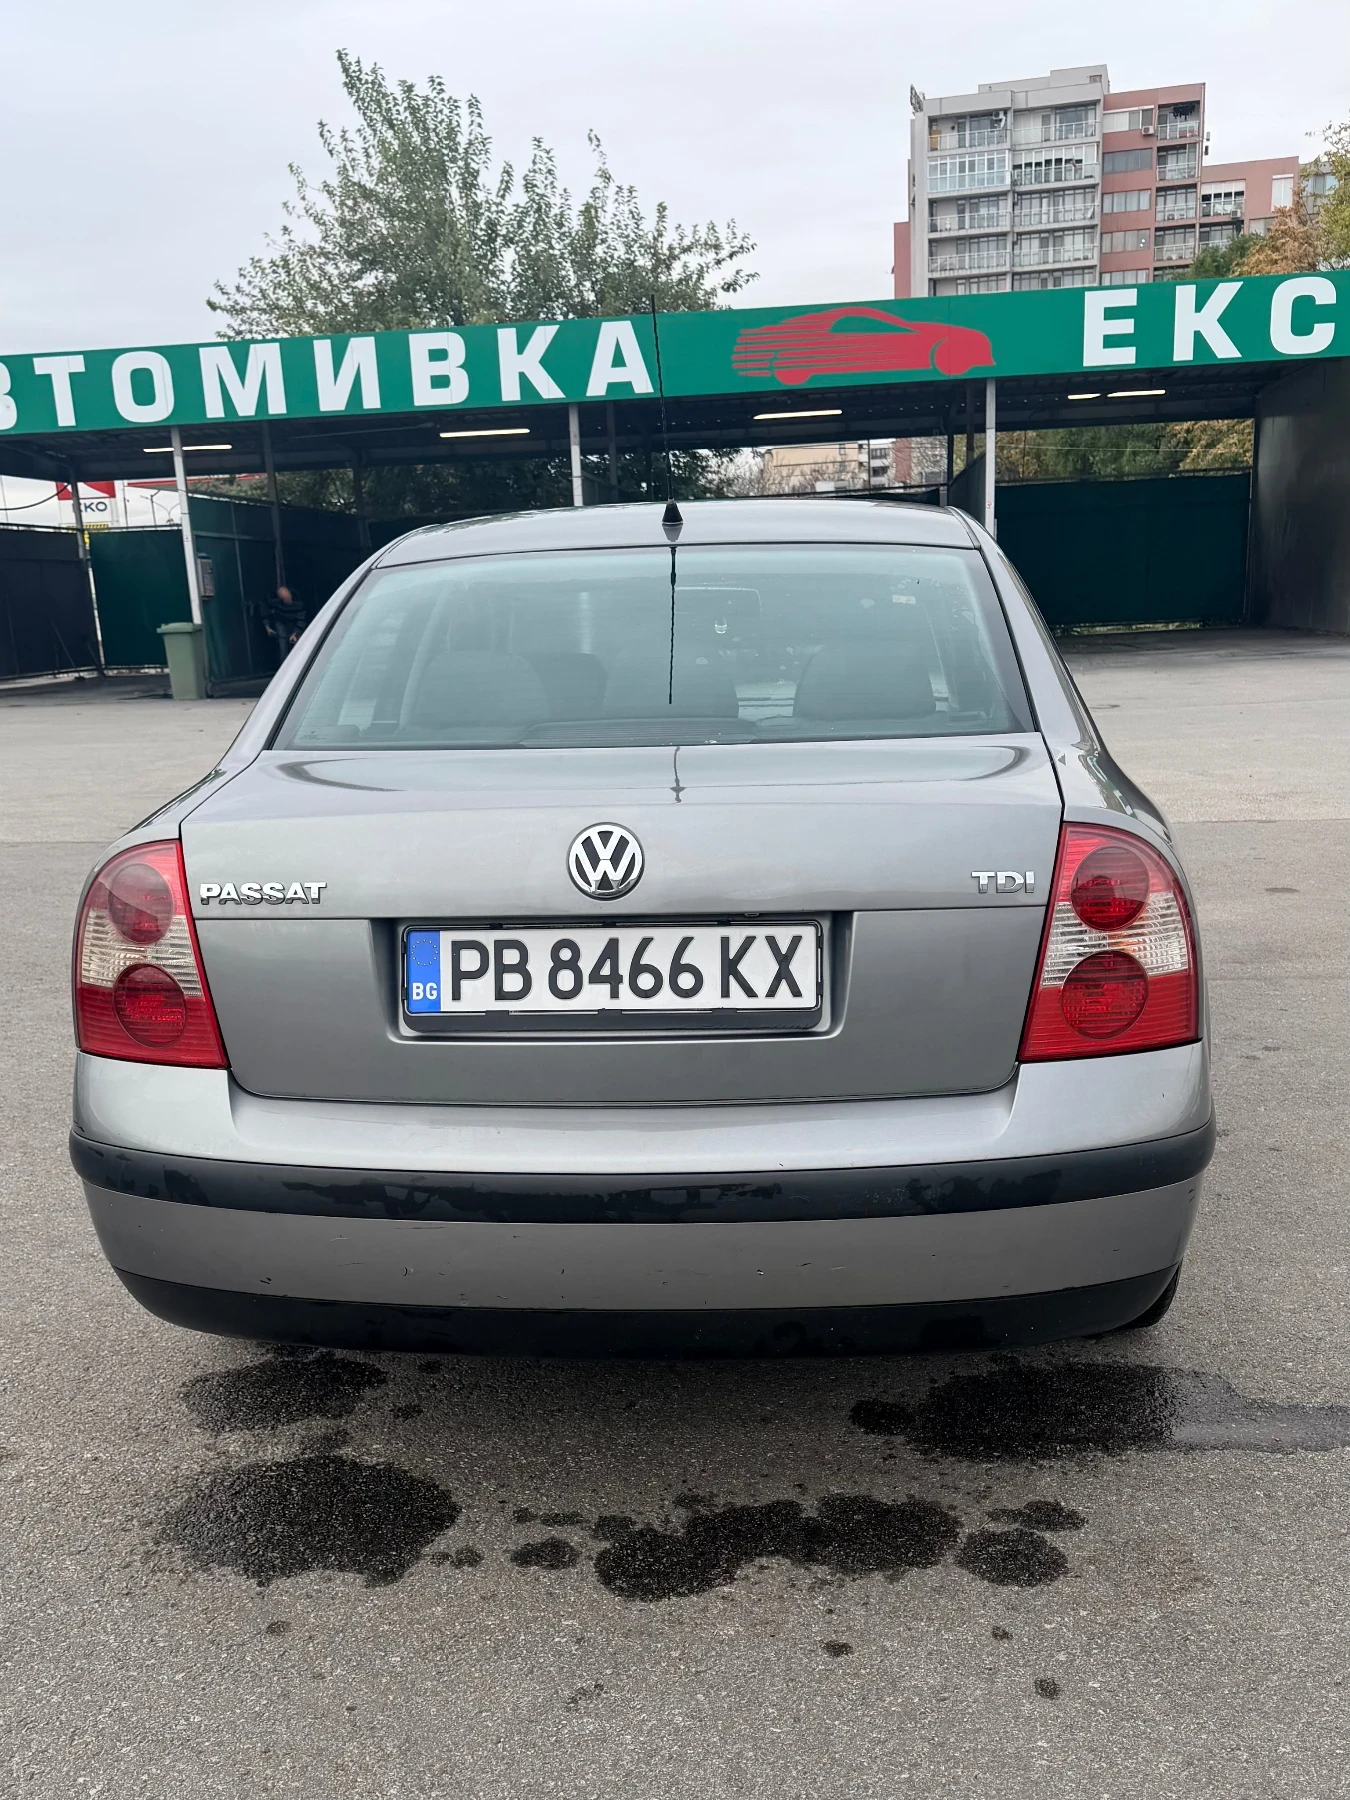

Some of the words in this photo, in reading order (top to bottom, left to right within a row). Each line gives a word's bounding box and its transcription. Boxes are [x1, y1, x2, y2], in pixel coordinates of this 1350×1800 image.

[1083, 276, 1337, 367] ЕКС
[971, 870, 1035, 893] TDI
[200, 882, 327, 905] PASSAT
[451, 939, 532, 1002] PB
[548, 937, 704, 1000] 8466
[720, 935, 804, 998] KX
[412, 983, 438, 1000] BG
